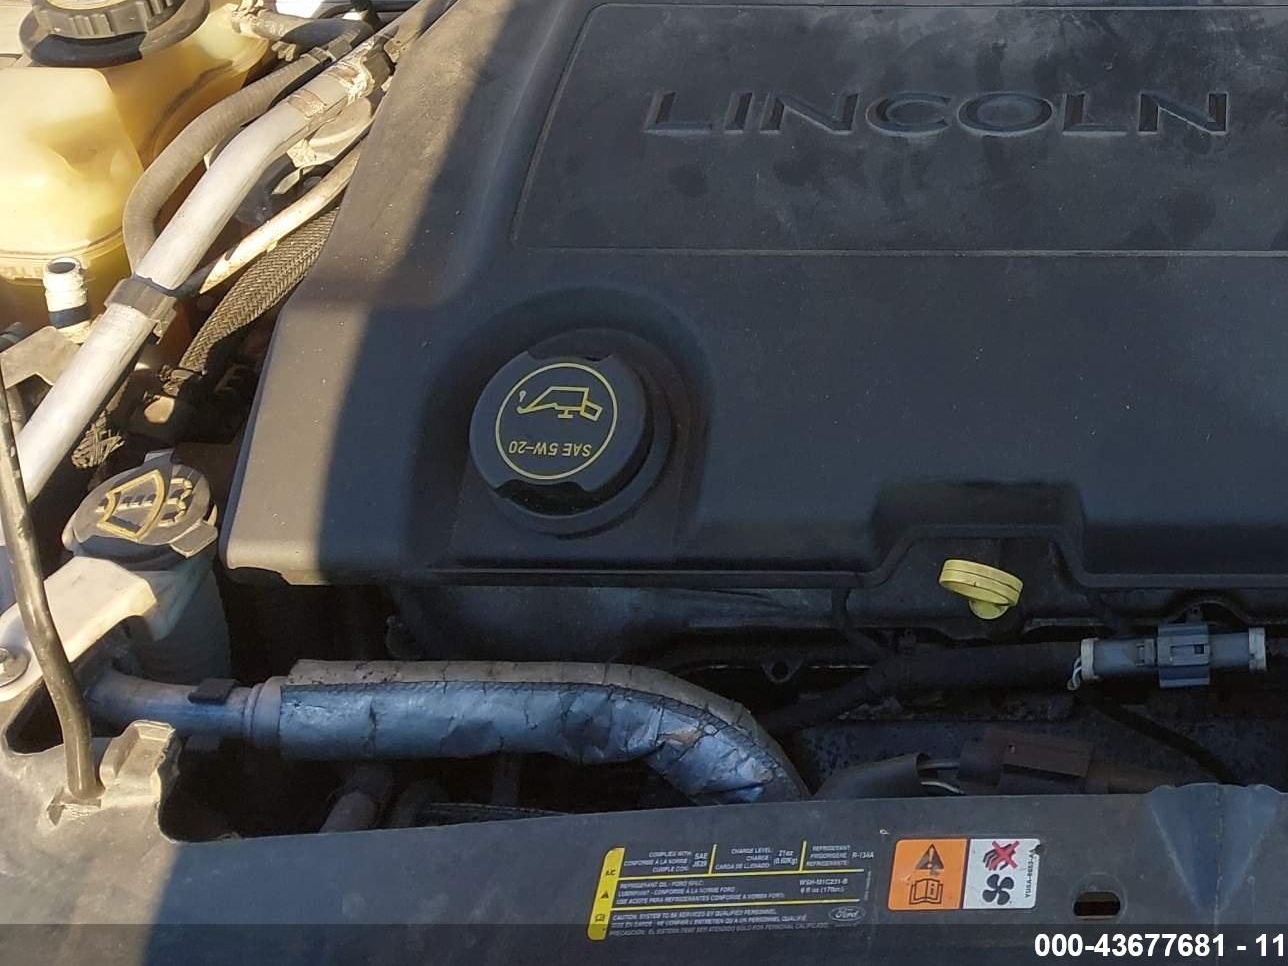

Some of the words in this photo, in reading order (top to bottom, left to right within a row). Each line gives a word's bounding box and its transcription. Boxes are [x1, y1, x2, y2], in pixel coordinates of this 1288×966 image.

[643, 90, 1229, 136] LINCOLN
[508, 440, 561, 457] 5W-20
[562, 442, 593, 457] SAE
[695, 852, 708, 860] SAE
